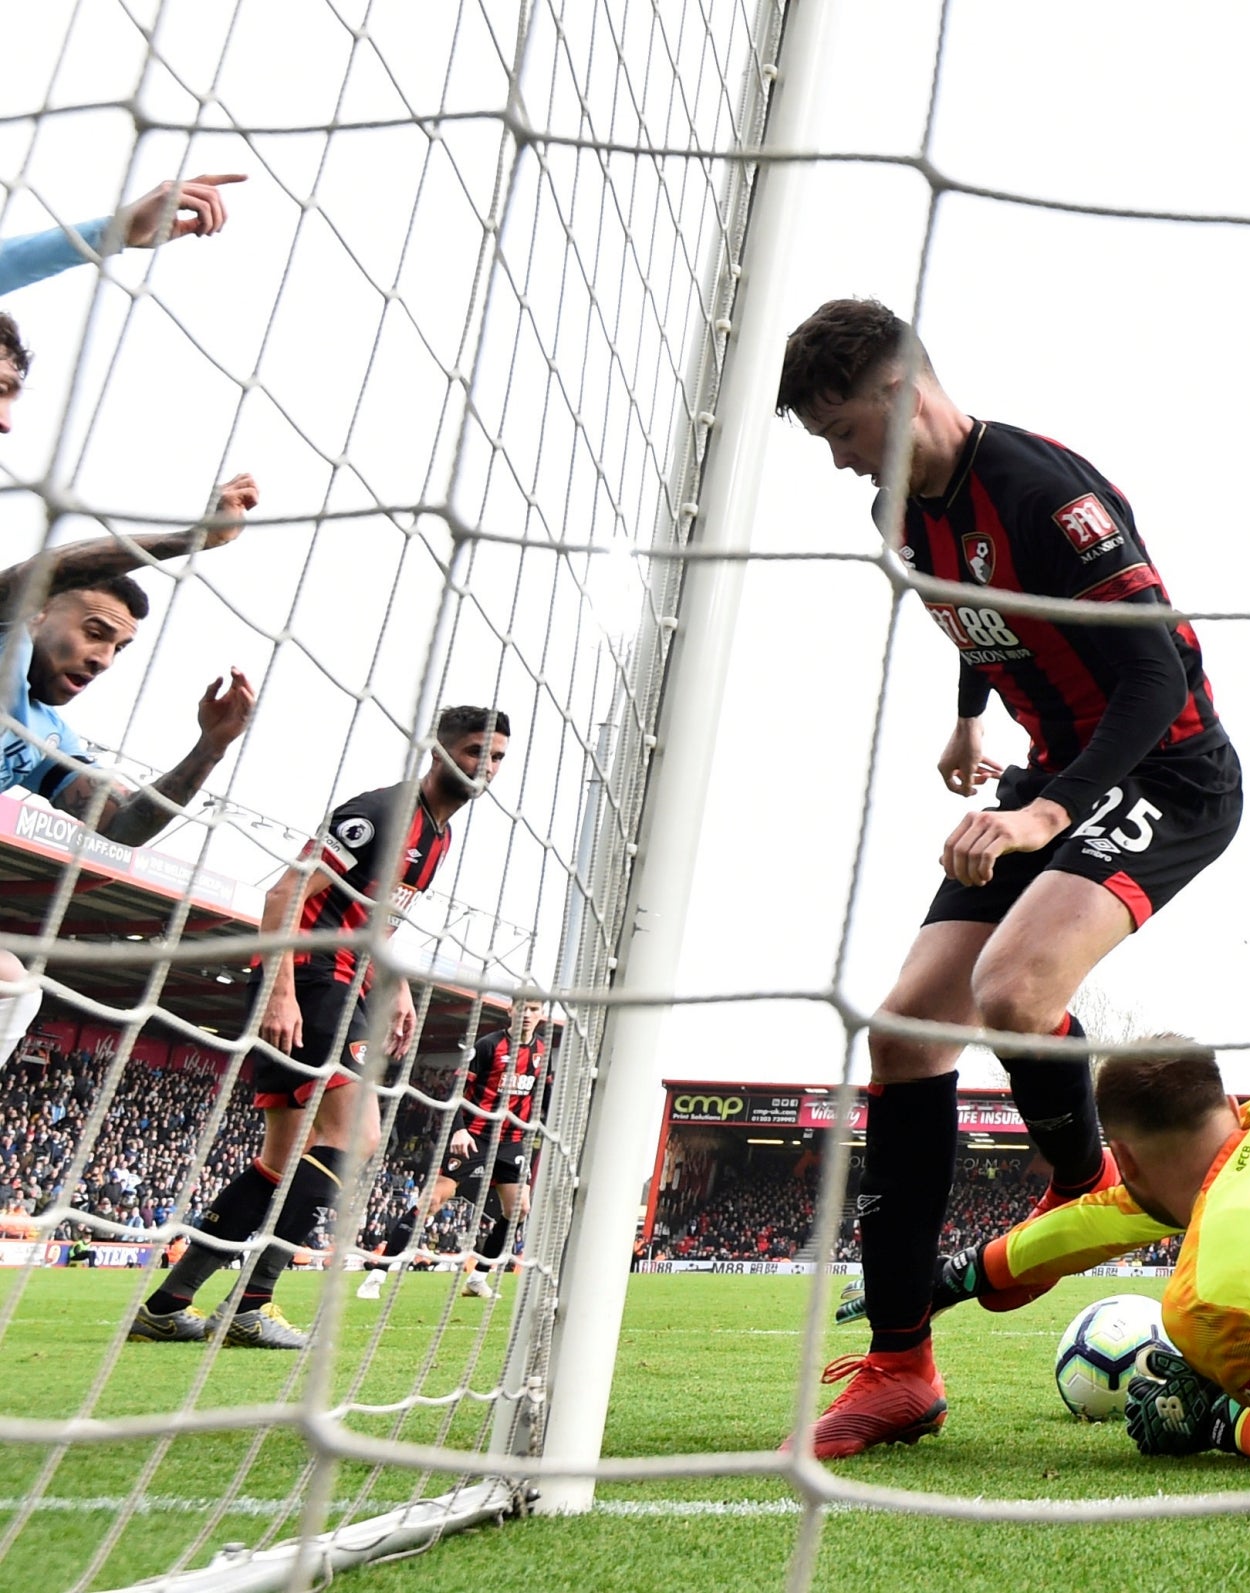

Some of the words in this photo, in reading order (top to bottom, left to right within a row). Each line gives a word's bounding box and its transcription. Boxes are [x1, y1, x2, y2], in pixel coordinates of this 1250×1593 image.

[1069, 786, 1163, 853] 25
[674, 1095, 744, 1121] cmp
[1235, 1145, 1250, 1172] AFCB
